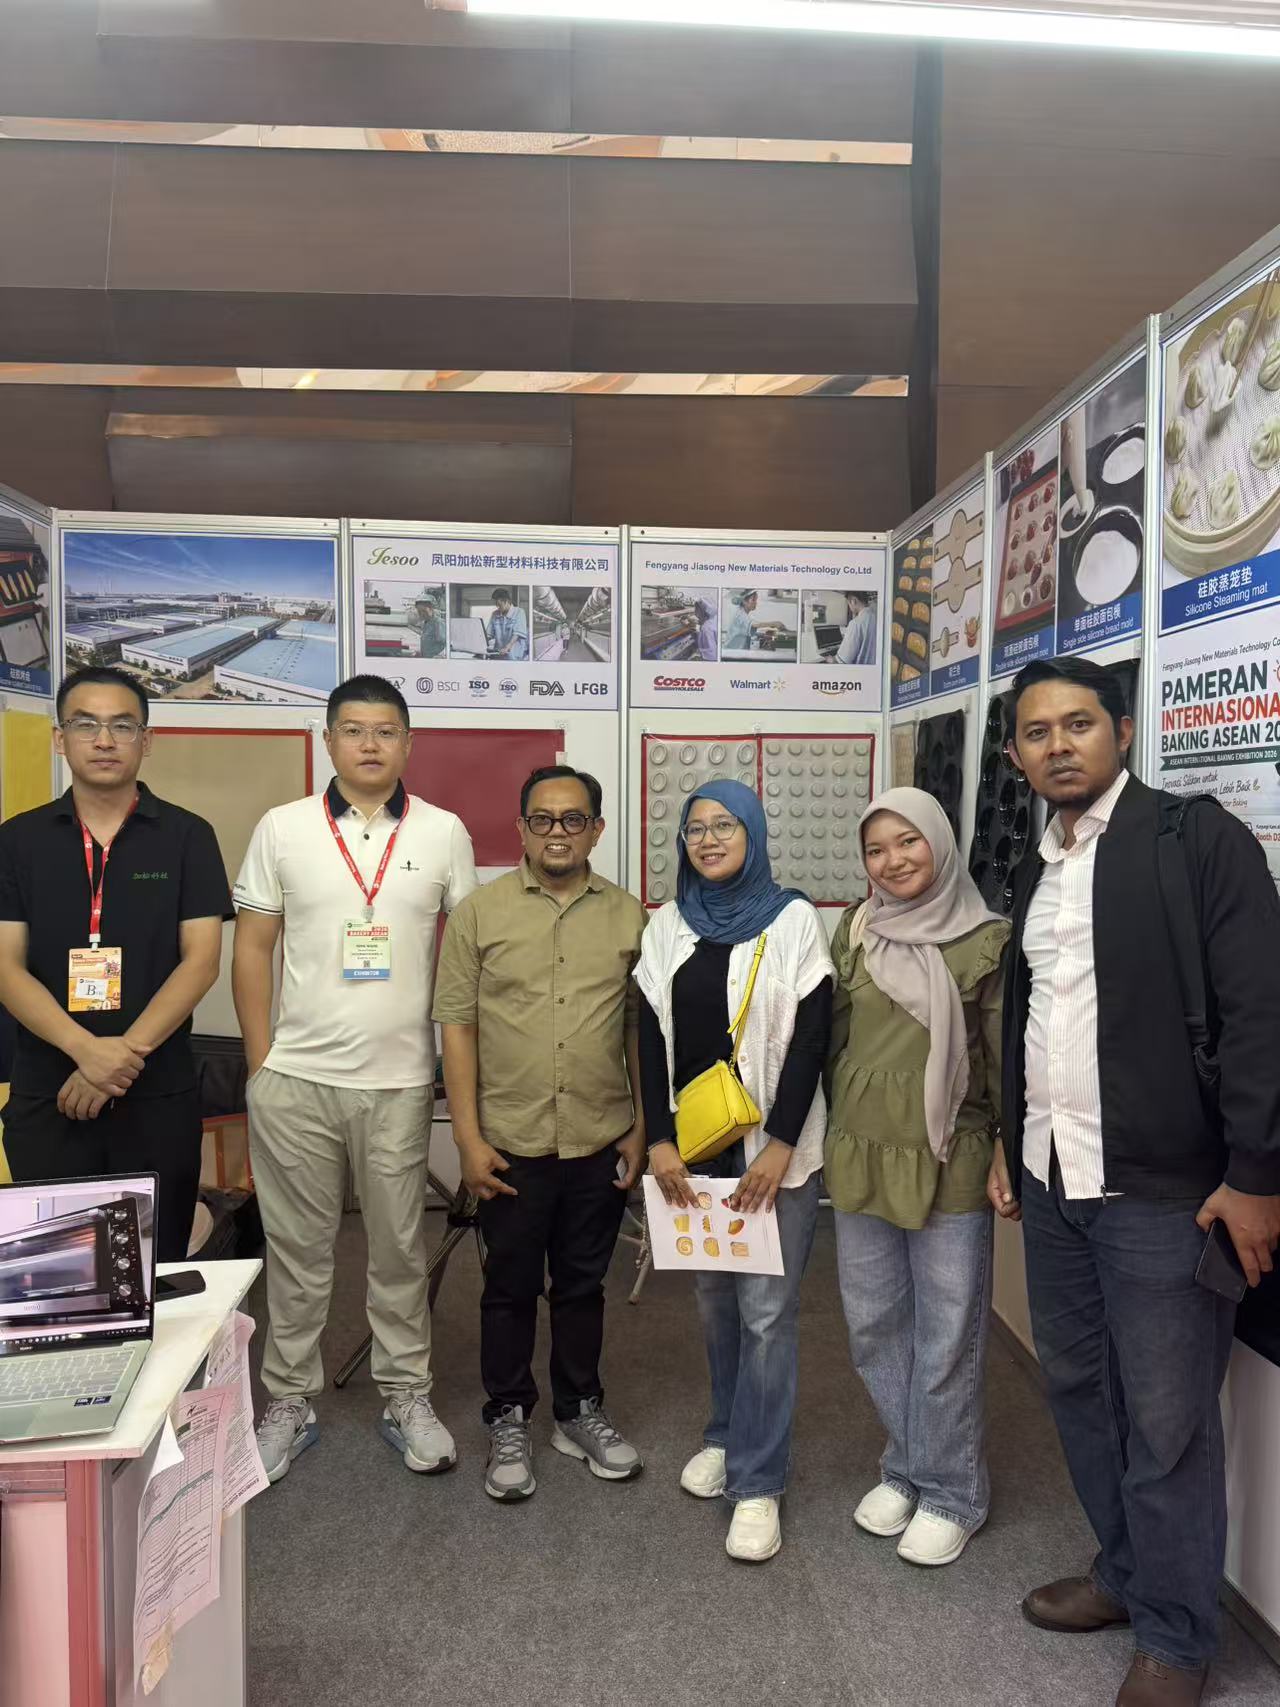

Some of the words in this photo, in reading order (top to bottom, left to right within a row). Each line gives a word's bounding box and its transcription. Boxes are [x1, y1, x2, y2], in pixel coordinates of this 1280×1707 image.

[431, 553, 609, 572] 凤阳加松新型材料科技有限公司
[645, 560, 689, 571] Fengyang
[691, 562, 726, 573] Jiasong
[728, 564, 747, 572] New
[749, 564, 789, 573] Materials
[791, 565, 841, 575] Technology
[1198, 565, 1252, 599] 硅胶蒸笼垫
[1185, 601, 1212, 617] Silicone
[1214, 590, 1250, 608] Steaming
[1252, 581, 1268, 597] mat
[1105, 622, 1120, 635] bread
[1202, 652, 1213, 662] New
[1214, 647, 1238, 659] Materials
[1240, 641, 1271, 654] Technology
[437, 681, 460, 691] BSCI
[469, 680, 490, 689] ISO
[501, 683, 517, 691] ISO
[529, 680, 566, 697] FDA
[574, 683, 609, 695] LFGB
[730, 679, 771, 689] Walmart
[812, 680, 862, 691] amazon
[1162, 660, 1268, 706] PAMERAN
[1162, 729, 1209, 753] BAKING
[1212, 723, 1261, 748] ASEAN
[1170, 758, 1182, 766] ASEAN
[1217, 753, 1234, 761] BAKING
[1236, 751, 1263, 760] EXHIBITION
[1265, 750, 1277, 758] 2026
[1202, 770, 1218, 782] untuk
[1220, 782, 1235, 795] Lebih
[1236, 780, 1251, 793] Baik
[1256, 832, 1272, 841] Booth
